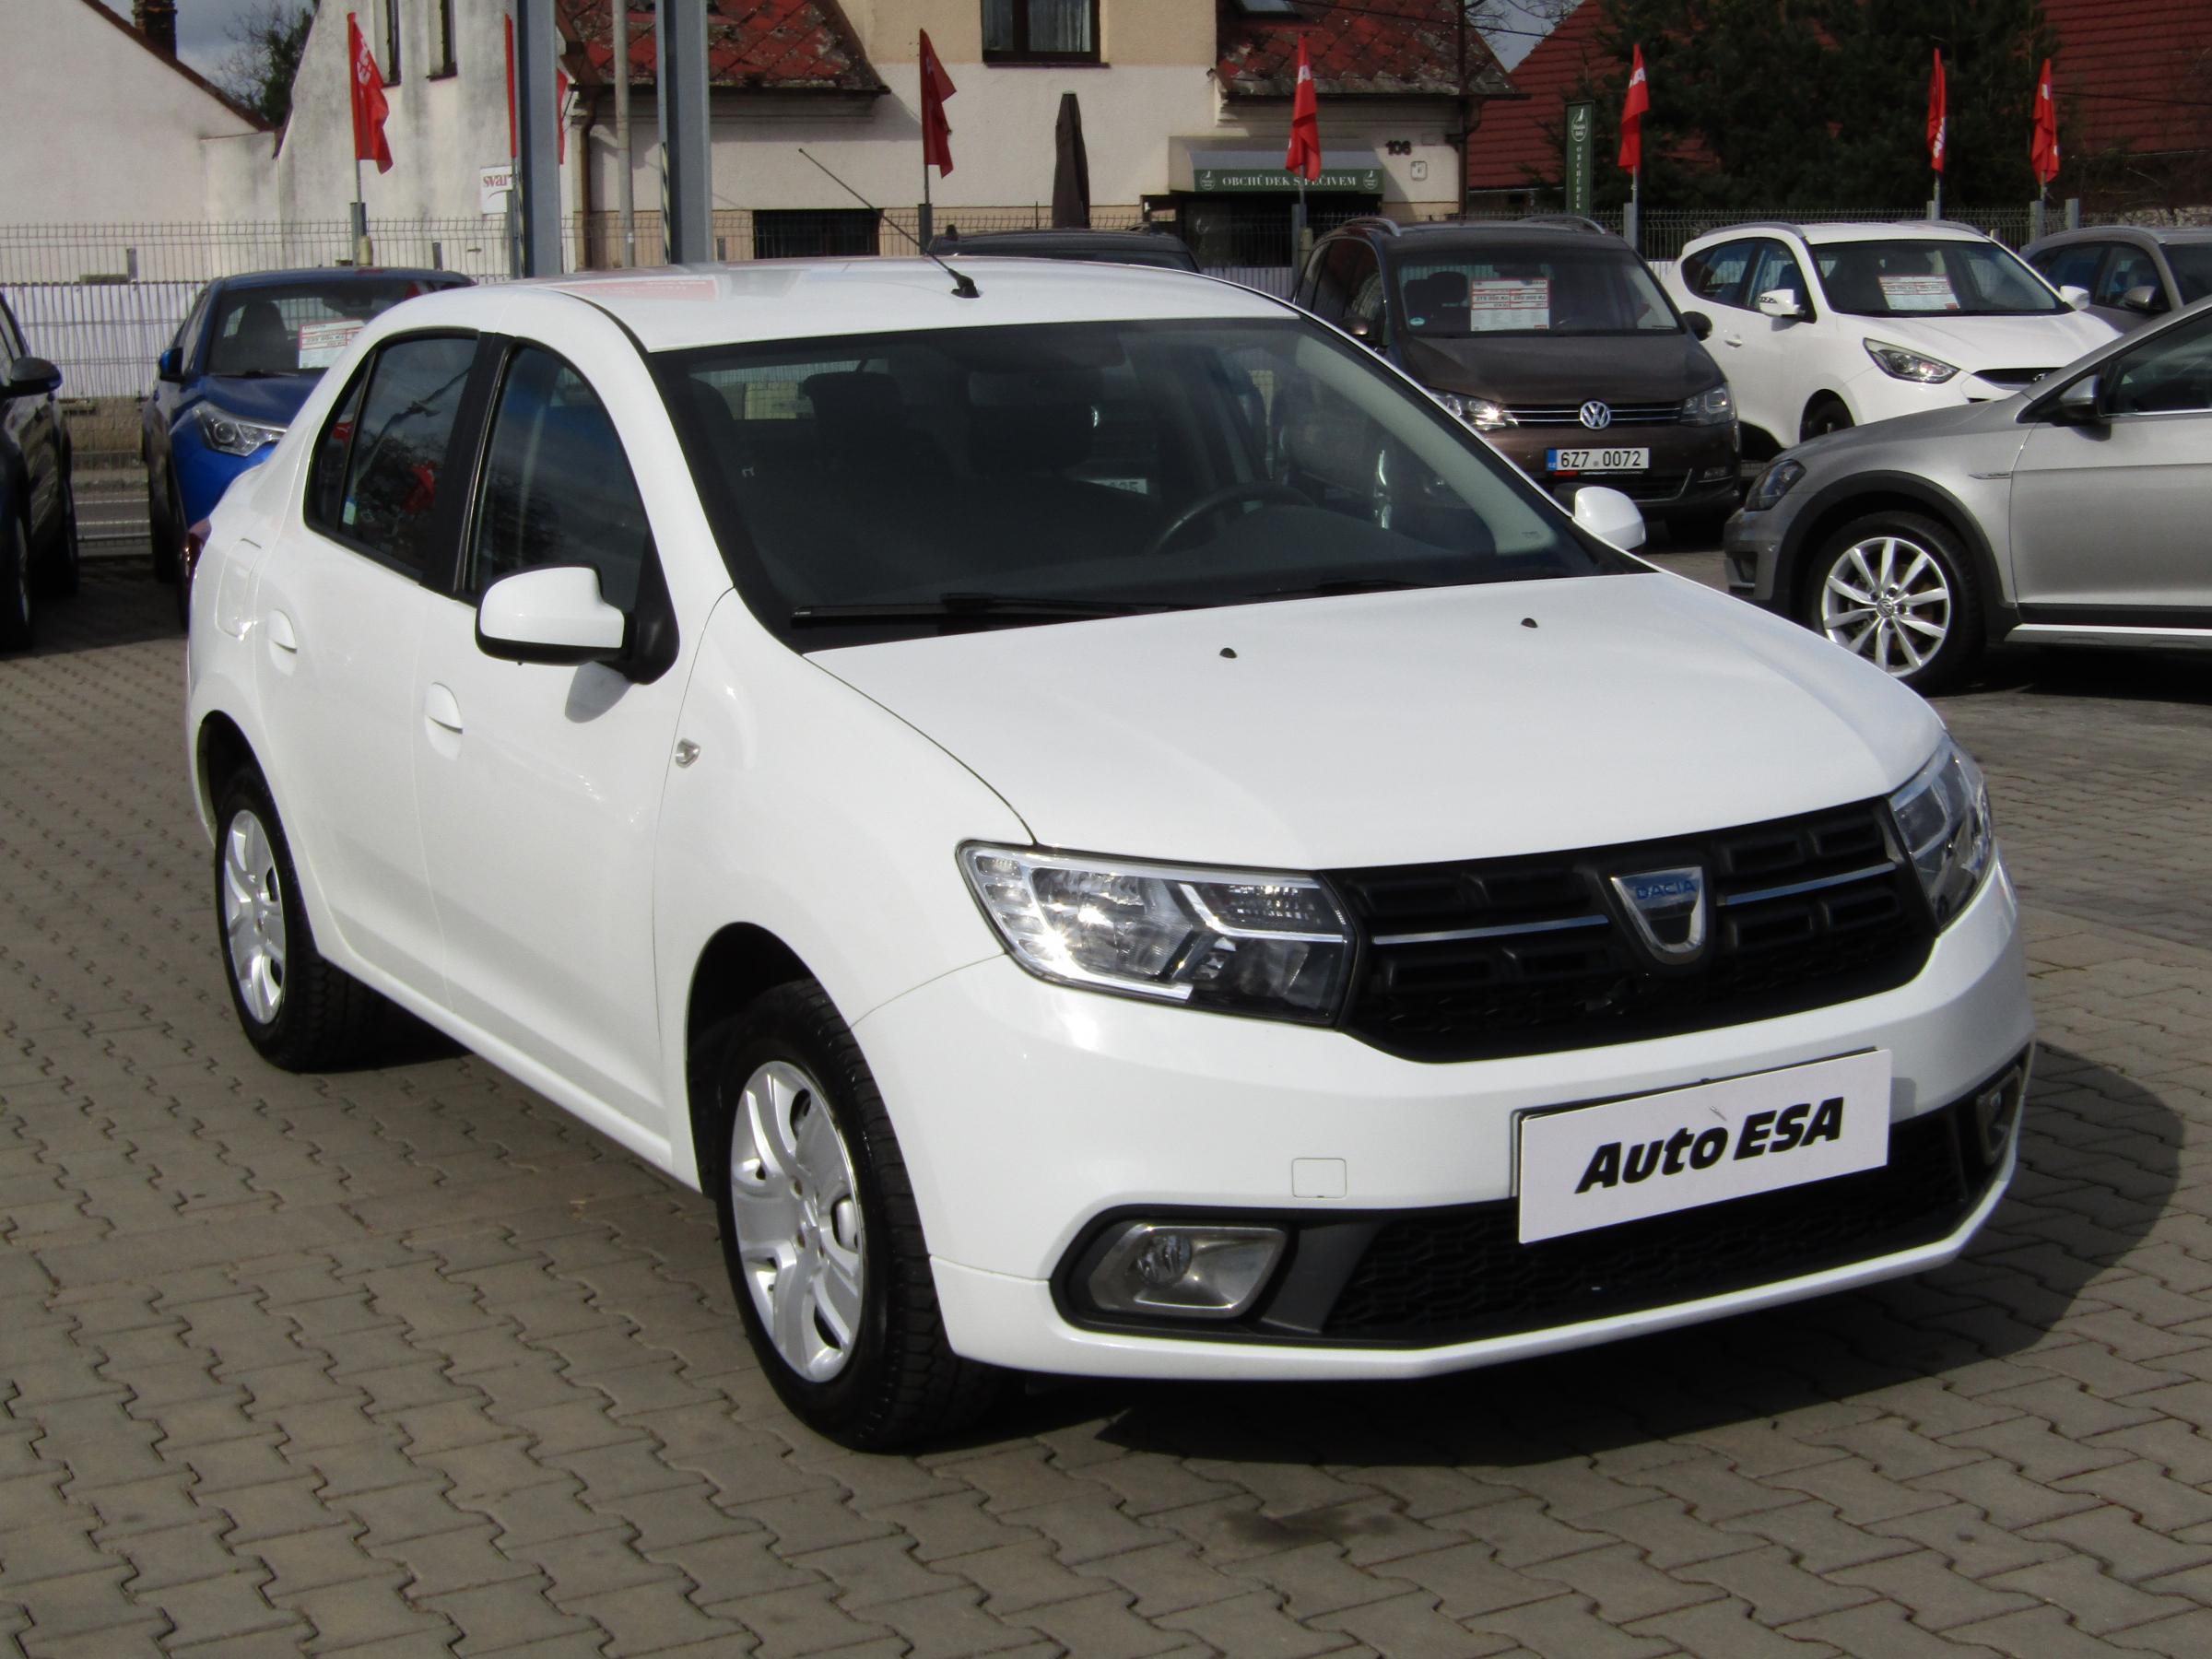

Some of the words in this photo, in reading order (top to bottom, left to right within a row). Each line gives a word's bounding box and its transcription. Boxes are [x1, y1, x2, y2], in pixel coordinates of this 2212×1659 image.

[1222, 173, 1289, 186] OBCHŮDEK
[1560, 452, 1590, 468] 6Z7
[1602, 450, 1641, 467] 0072
[1636, 879, 1696, 900] DACIA
[1574, 1126, 1729, 1194] Auto
[1733, 1096, 1844, 1161] ESA
